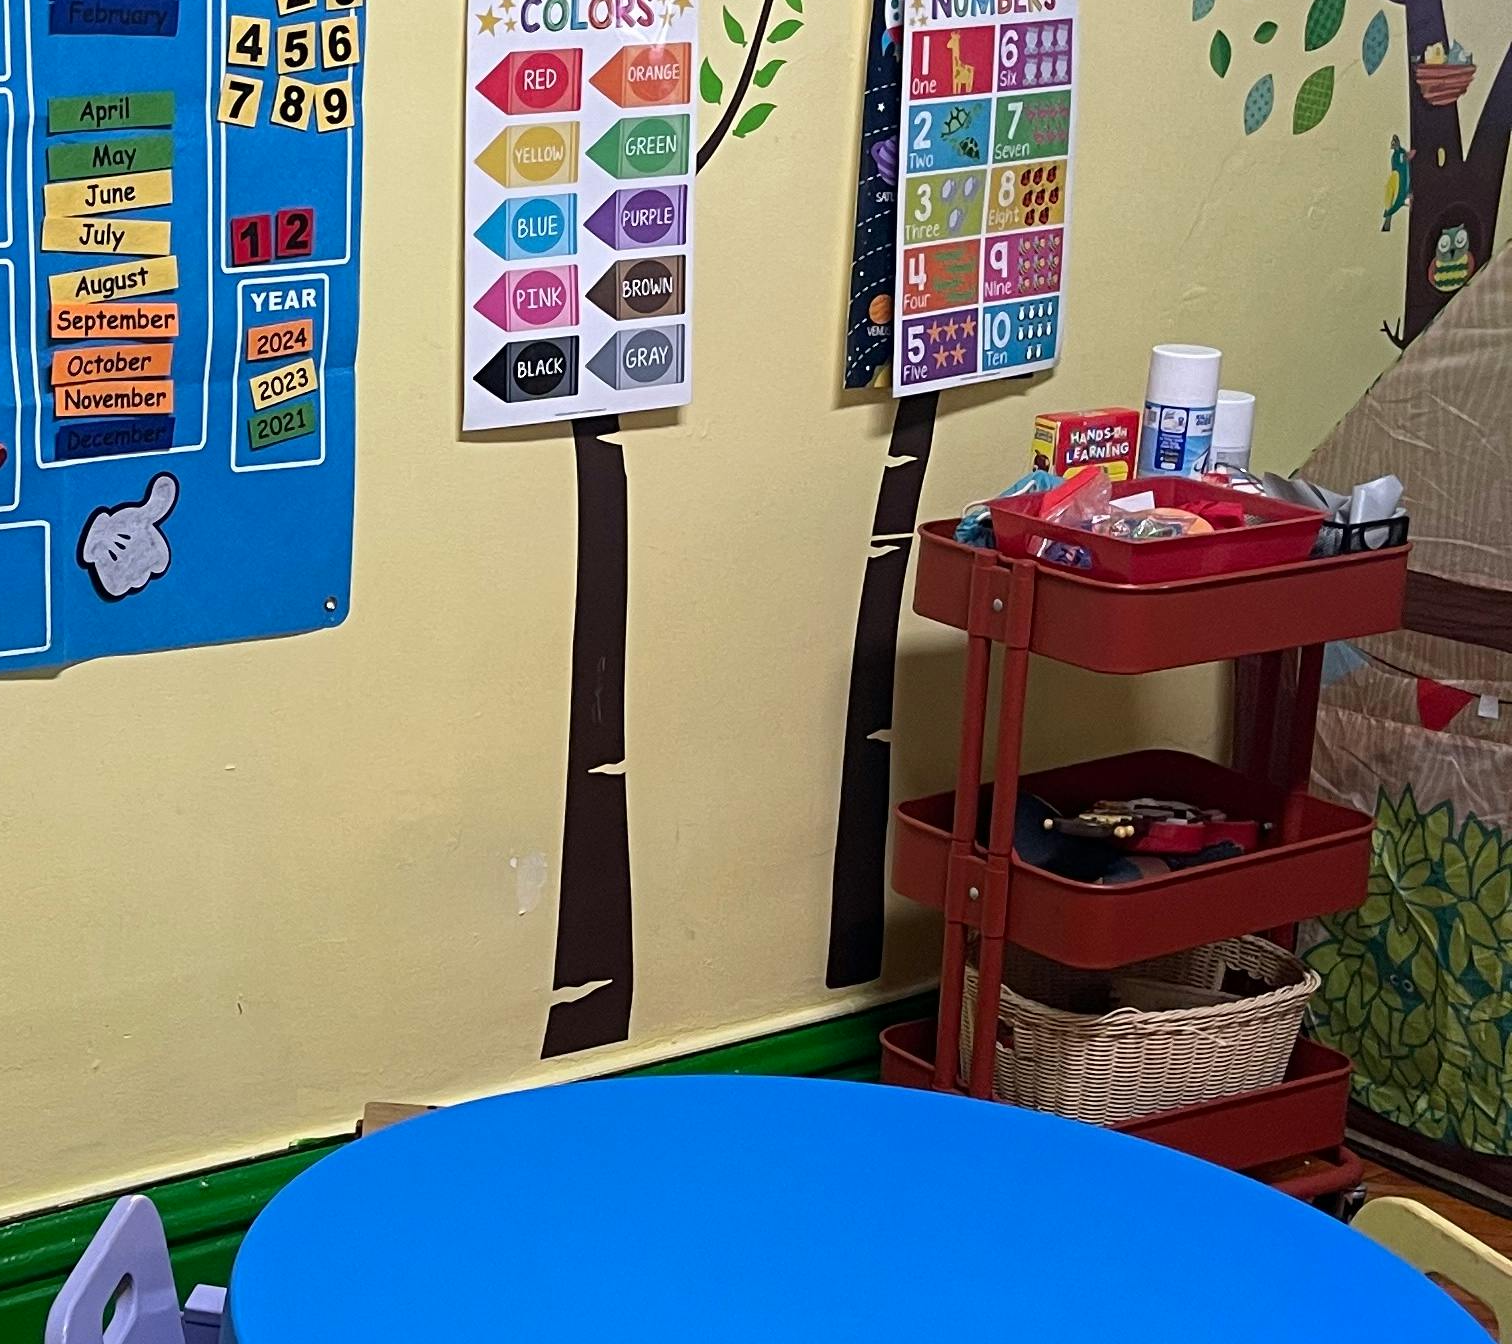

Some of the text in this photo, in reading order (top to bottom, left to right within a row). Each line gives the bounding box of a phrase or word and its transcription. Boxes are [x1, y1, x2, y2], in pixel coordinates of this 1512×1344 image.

[68, 5, 168, 30] February
[235, 22, 352, 68] 4 5 6
[920, 36, 930, 75] 1
[1000, 30, 1019, 68] 6
[523, 68, 556, 91] RED
[627, 63, 680, 83] ORANGE
[999, 70, 1017, 87] Six
[912, 77, 937, 95] One
[79, 97, 130, 123] April
[228, 80, 348, 125] 7 8 9
[913, 111, 932, 151] 2
[1006, 102, 1023, 140] 7
[92, 145, 137, 169] May
[514, 144, 564, 164] YELLOW
[625, 134, 677, 156] GREEN
[994, 142, 1030, 159] Seven
[910, 152, 933, 169] Two
[84, 184, 136, 207] June
[997, 170, 1015, 208] 8
[913, 183, 932, 222] 3
[516, 216, 558, 238] BLUE
[621, 206, 673, 228] PURPLE
[988, 208, 1019, 227] Eight
[78, 225, 125, 250] July
[904, 222, 940, 239] Three
[990, 240, 1008, 278] 9
[74, 267, 148, 299] August
[908, 253, 927, 290] 4
[516, 286, 562, 310] PINK
[621, 276, 674, 298] BROWN
[984, 280, 1012, 297] Nine
[250, 288, 317, 313] YEAR
[904, 290, 932, 309] Four
[56, 309, 175, 336] September
[984, 310, 1011, 349] 10
[256, 328, 307, 355] 2024
[907, 325, 925, 363] 5
[67, 353, 151, 377] October
[516, 356, 563, 378] BLACK
[625, 345, 669, 369] GRAY
[985, 349, 1008, 366] Ten
[903, 362, 928, 380] Five
[257, 368, 309, 401] 2023
[64, 387, 166, 410] November
[257, 408, 307, 439] 2021
[68, 426, 166, 449] December
[1066, 442, 1129, 464] LEARNING
